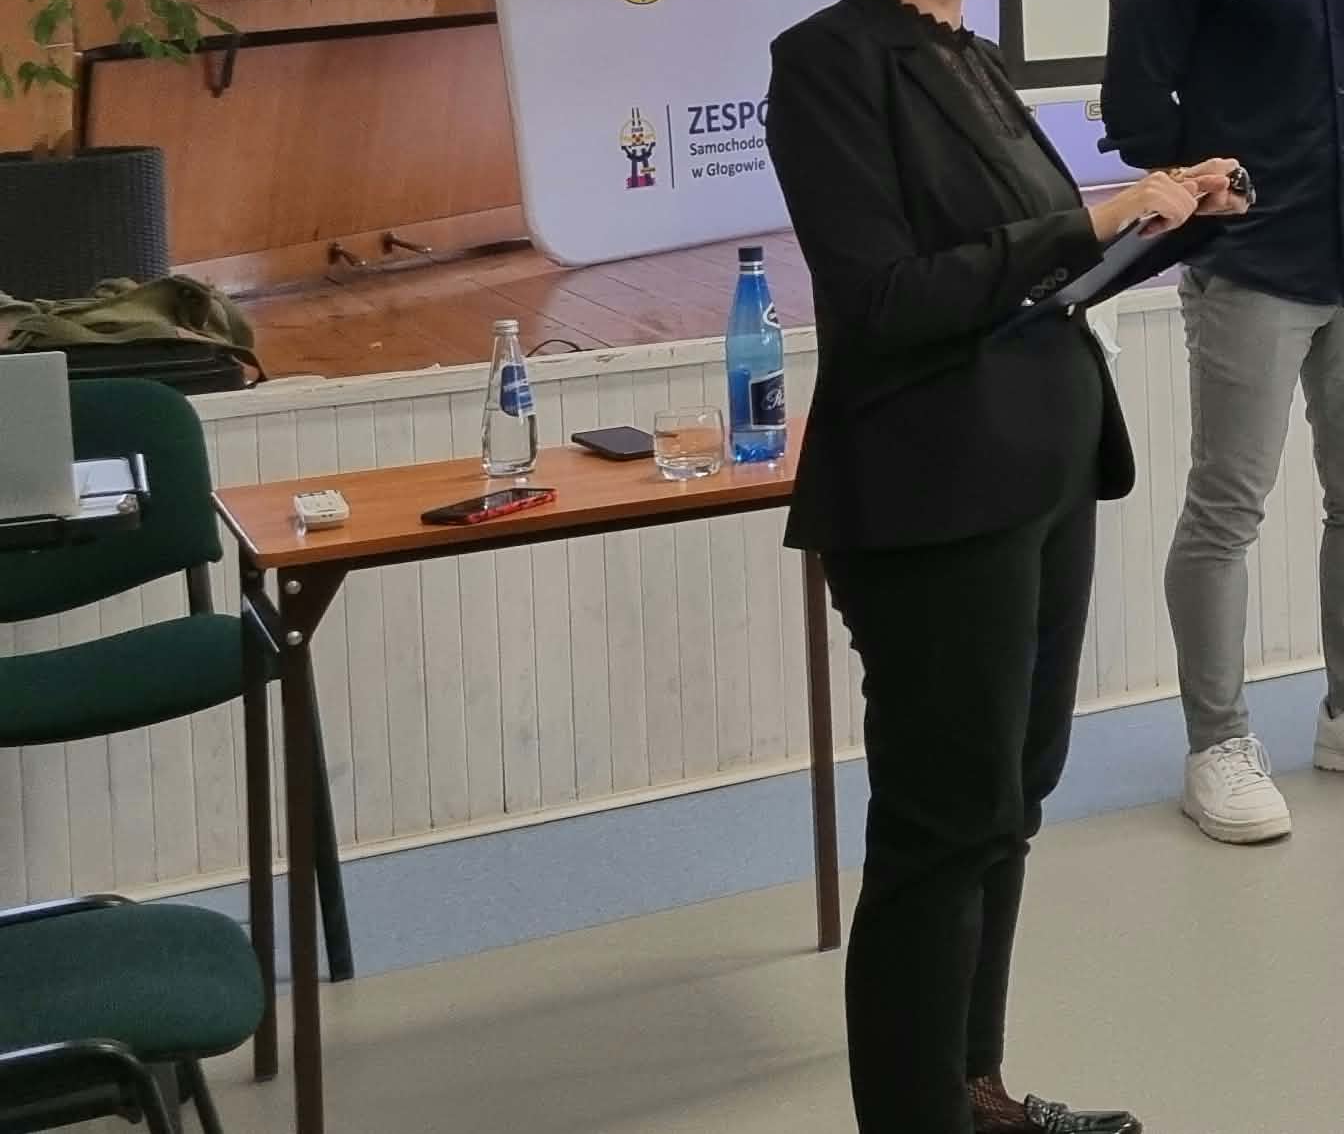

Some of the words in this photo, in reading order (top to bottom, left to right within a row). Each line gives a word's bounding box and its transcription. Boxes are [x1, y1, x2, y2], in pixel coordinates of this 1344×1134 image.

[689, 135, 764, 156] Samochodo
[692, 167, 703, 179] w
[706, 157, 766, 177] Głogowie
